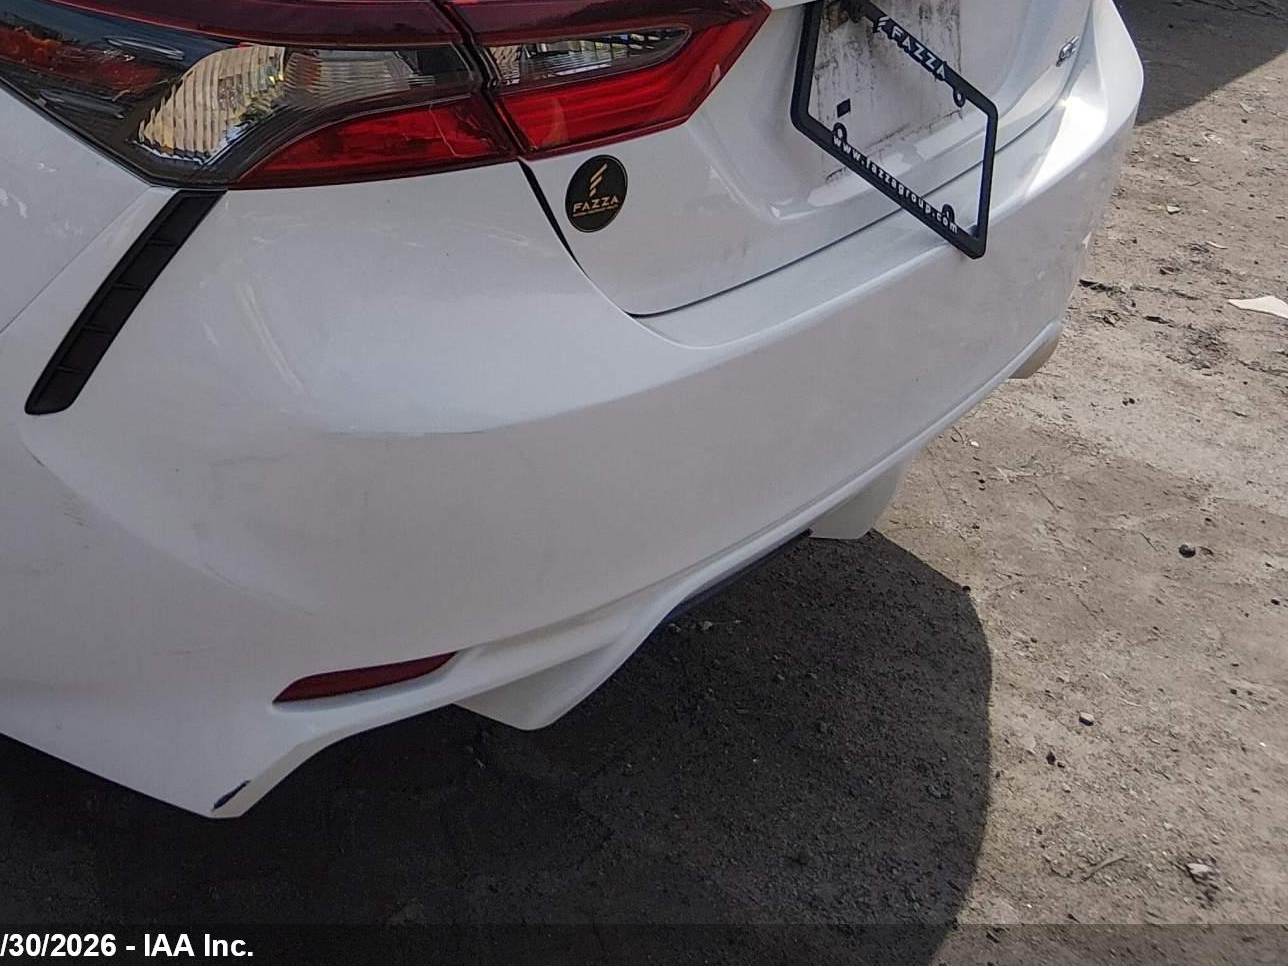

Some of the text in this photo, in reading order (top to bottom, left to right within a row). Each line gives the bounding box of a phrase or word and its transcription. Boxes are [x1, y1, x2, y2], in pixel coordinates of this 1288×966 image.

[890, 24, 948, 80] FAZZA
[571, 194, 619, 213] FAZZA
[832, 135, 959, 235] www.fazzagroup.com
